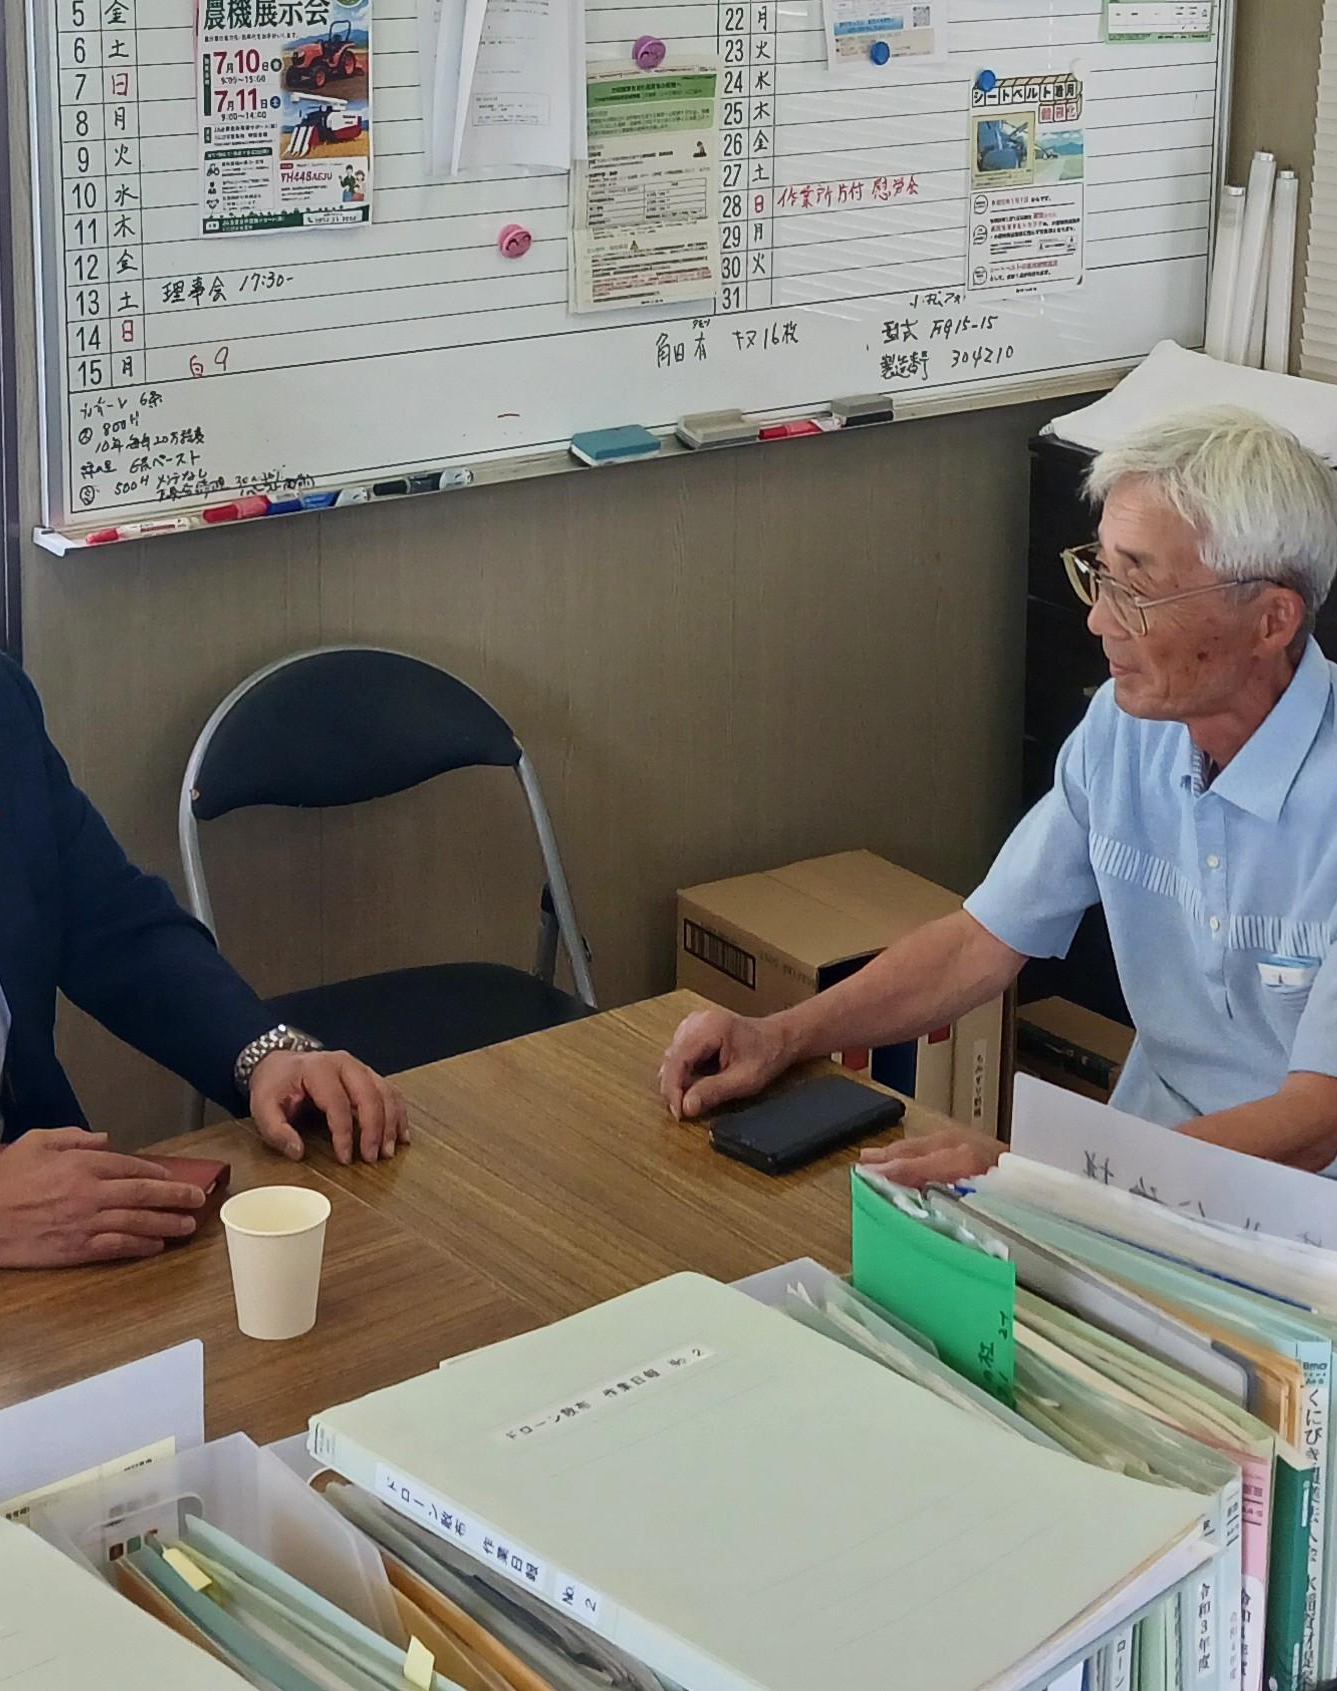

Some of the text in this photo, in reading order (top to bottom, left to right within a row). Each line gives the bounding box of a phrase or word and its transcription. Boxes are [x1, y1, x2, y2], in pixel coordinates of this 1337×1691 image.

[72, 1, 84, 27] 5
[203, 0, 330, 31] 農機展示会
[725, 7, 744, 31] 22
[757, 5, 767, 31] 月
[74, 37, 86, 63] 6
[108, 40, 129, 58] 土
[725, 39, 744, 63] 23
[755, 40, 771, 59] 火
[75, 74, 86, 100] 7
[111, 72, 128, 96] 日
[724, 70, 743, 94] 24
[755, 71, 771, 90] 水
[114, 106, 126, 132] 月
[724, 102, 743, 125] 25
[753, 101, 770, 120] 木
[76, 110, 88, 136] 8
[114, 143, 132, 167] 火
[723, 133, 742, 156] 26
[78, 147, 89, 172] 9
[723, 164, 742, 187] 27
[752, 163, 769, 182] 土
[72, 183, 96, 209] 10
[114, 184, 139, 207] 水
[722, 195, 742, 218] 28
[754, 194, 764, 214] 日
[74, 218, 96, 245] 11
[114, 214, 135, 238] 木
[722, 225, 741, 249] 29
[753, 223, 763, 243] 月
[74, 254, 99, 280] 12
[721, 256, 741, 279] 30
[752, 252, 766, 274] 火
[76, 290, 100, 316] 13
[117, 291, 139, 312] 土
[161, 276, 227, 306] 理事会
[722, 287, 740, 309] 31
[76, 325, 101, 351] 14
[121, 319, 134, 342] 日
[122, 355, 134, 377] 月
[951, 346, 1013, 369] 304210
[78, 359, 103, 386] 15
